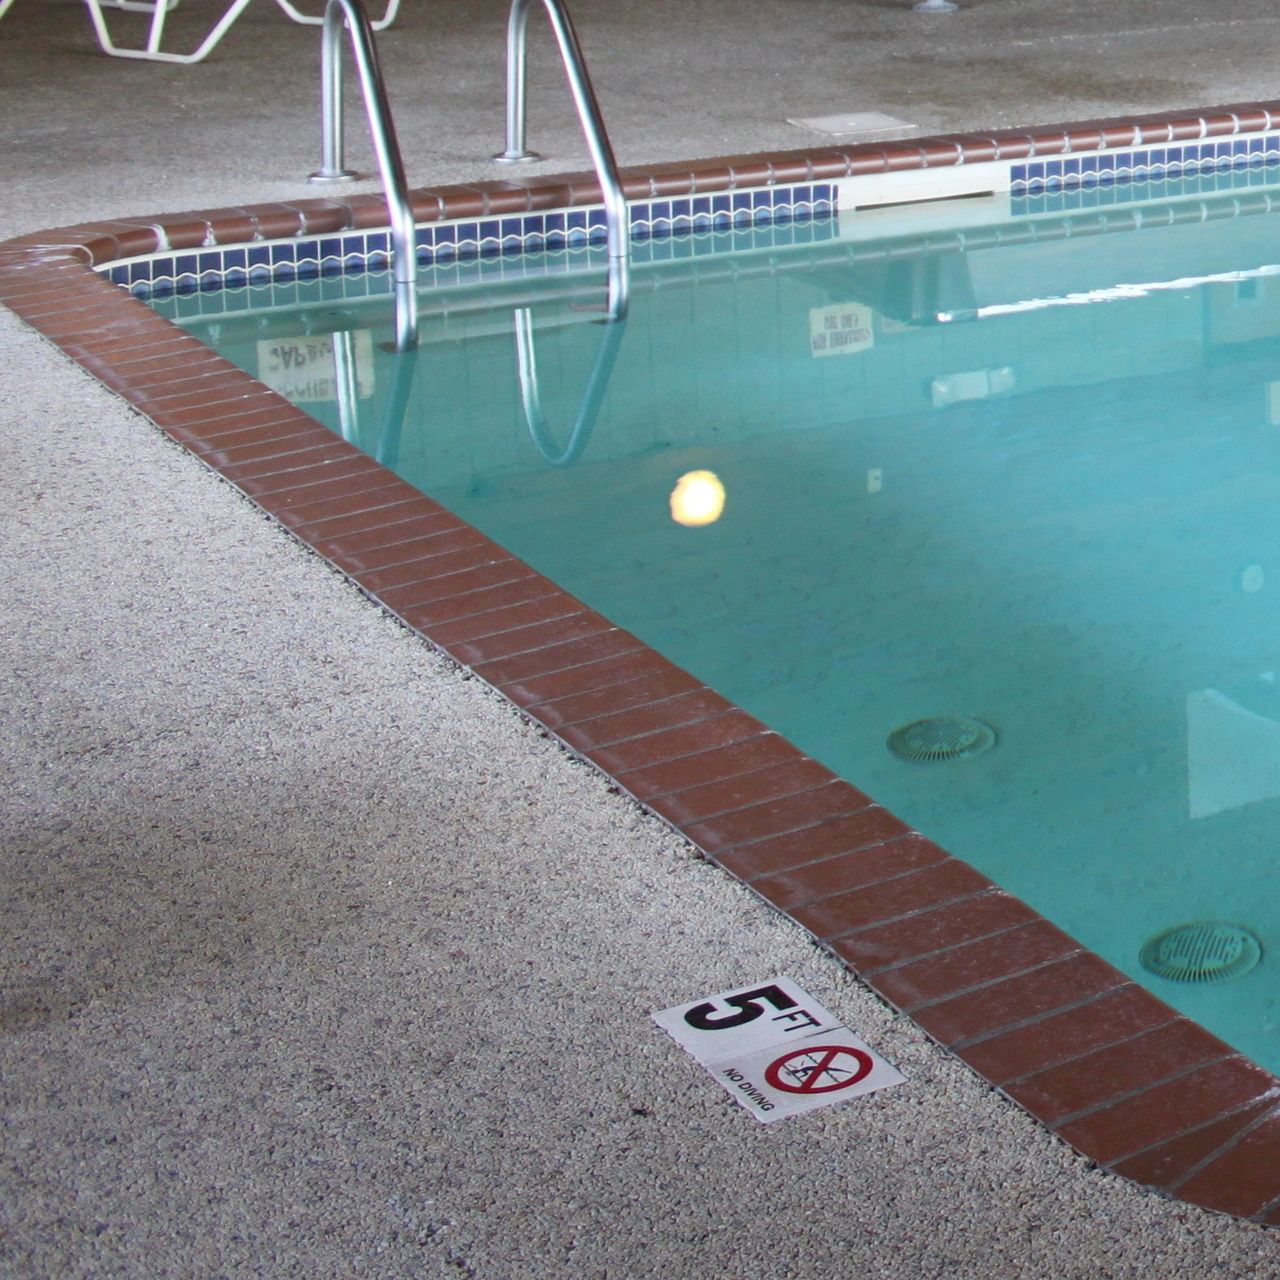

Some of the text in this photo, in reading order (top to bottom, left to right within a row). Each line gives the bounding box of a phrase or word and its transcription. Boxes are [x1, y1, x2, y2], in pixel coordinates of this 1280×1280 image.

[684, 984, 822, 1032] 5 FT
[722, 1068, 775, 1111] NO DIVING
